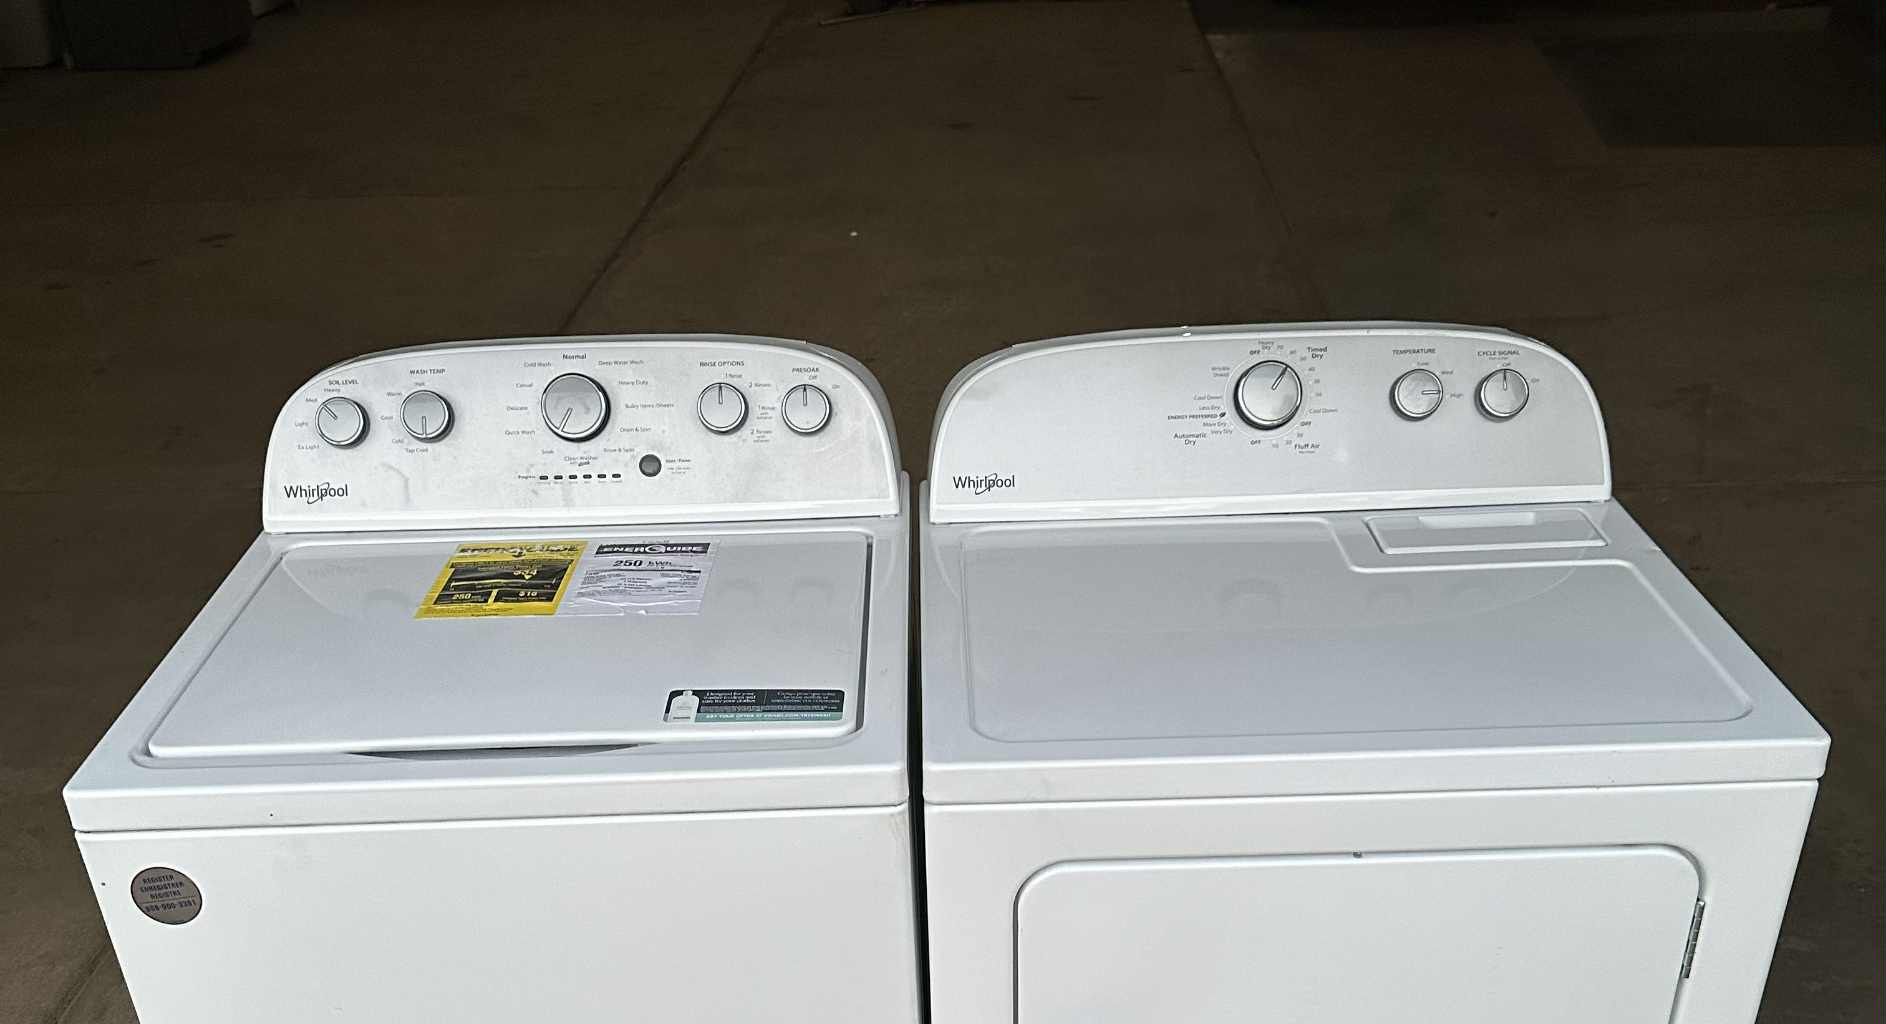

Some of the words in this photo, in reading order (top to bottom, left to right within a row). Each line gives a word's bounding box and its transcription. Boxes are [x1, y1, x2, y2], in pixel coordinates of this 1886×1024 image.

[1392, 348, 1436, 356] TEMPERATURE
[328, 379, 342, 387] SOIL
[342, 378, 359, 386] LEVEL
[1184, 438, 1197, 446] Dry
[953, 473, 1015, 495] Whirlpool
[284, 482, 349, 504] Whirlpool
[612, 559, 644, 568] 250
